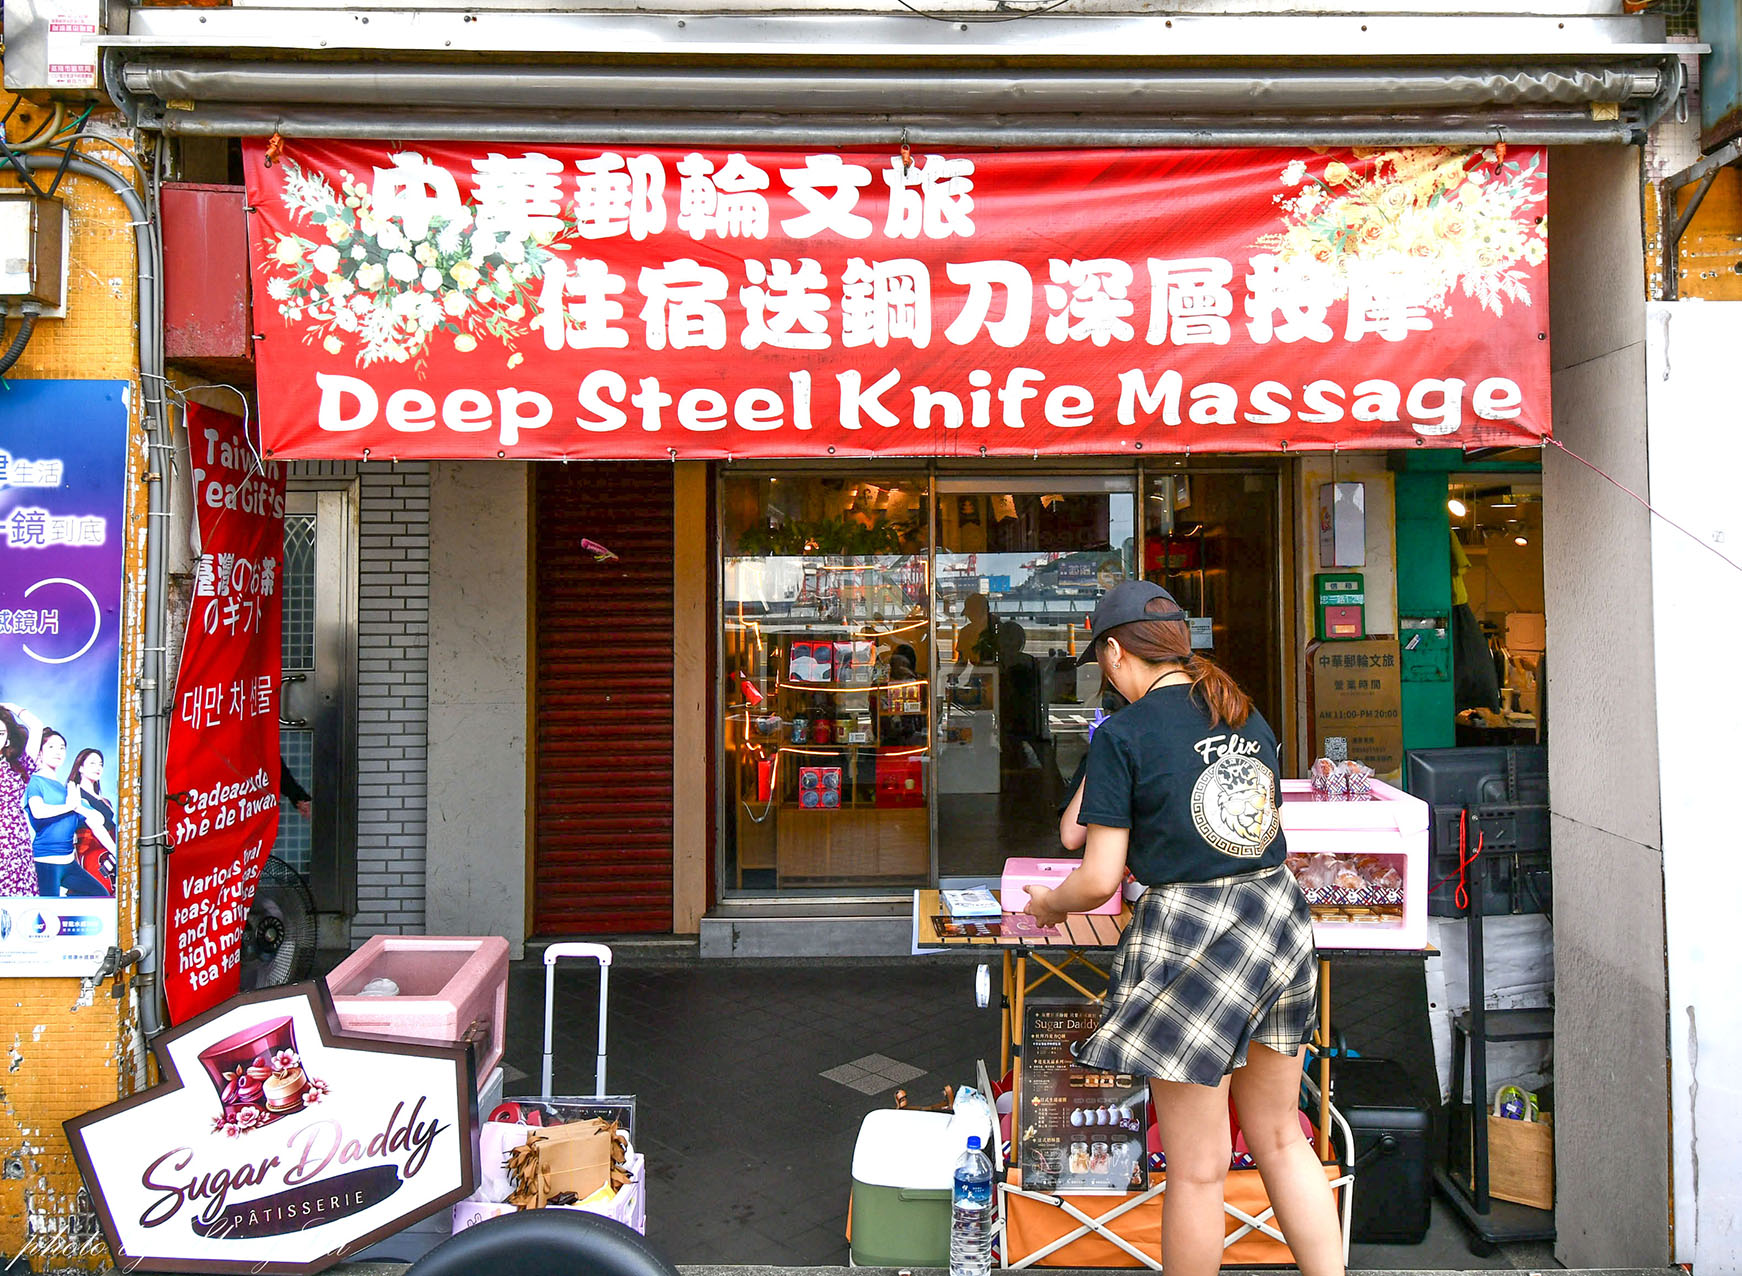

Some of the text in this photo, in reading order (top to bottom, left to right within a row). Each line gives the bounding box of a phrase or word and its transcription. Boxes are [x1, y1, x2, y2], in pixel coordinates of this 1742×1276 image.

[372, 152, 976, 243] 中華郵輪文旅
[537, 252, 1434, 351] 住宿送鋼刀深層按摩
[316, 367, 1522, 446] Deep Steel Knife Massage
[203, 428, 280, 480] Taiwn
[194, 468, 238, 511] Tea
[0, 510, 102, 545] 鏡到底
[204, 593, 262, 636] のギフト
[182, 675, 273, 730] 대만 차 선물
[1374, 709, 1398, 718] 20:00
[1193, 734, 1261, 765] Felix
[184, 767, 269, 814] Cadeaux de
[176, 810, 210, 845] thé
[215, 805, 236, 830] de
[174, 898, 215, 928] teas,
[178, 915, 208, 950] and
[179, 937, 217, 974] high
[189, 963, 219, 991] tea
[1034, 1019, 1100, 1032] Sugar Daddy
[139, 1096, 451, 1228] Sugar Daddy
[234, 1191, 365, 1228] PÂTISSERIE
